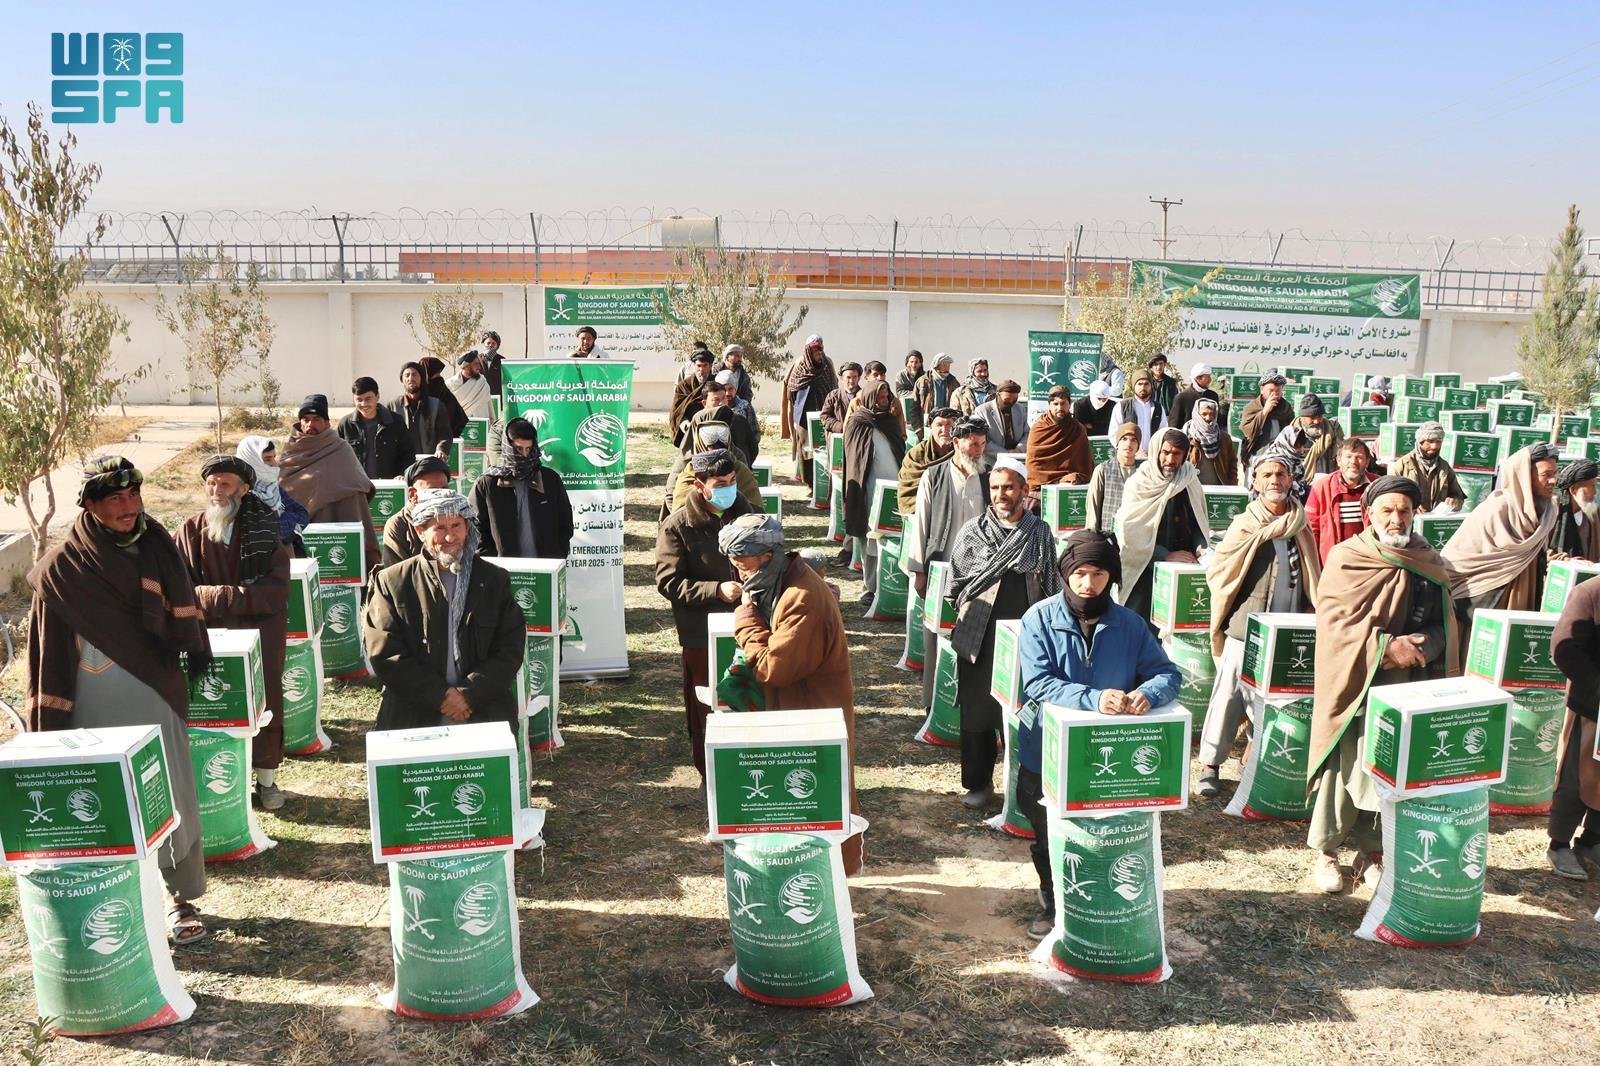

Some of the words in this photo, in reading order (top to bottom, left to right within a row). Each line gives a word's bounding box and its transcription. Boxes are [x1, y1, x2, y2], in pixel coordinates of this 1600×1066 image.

[1262, 272, 1301, 284] العربية
[1303, 274, 1348, 285] المملكة
[1207, 282, 1257, 293] KINGDOM
[1259, 286, 1274, 295] OF
[1275, 287, 1308, 296] SAUDI
[1310, 288, 1349, 297] ARABIA
[507, 381, 554, 392] السعودية
[556, 379, 590, 392] العربية
[591, 380, 628, 390] المملكة
[507, 394, 552, 403] KINGDOM
[553, 394, 565, 402] OF
[567, 393, 595, 402] SAUDI
[596, 393, 628, 401] ARABIA
[572, 545, 618, 555] EMERGENCIES
[570, 559, 587, 568] YEAR
[588, 559, 605, 567] 2025
[738, 752, 769, 760] السعودية
[402, 768, 434, 776] السعودية
[435, 766, 458, 774] العربية
[458, 763, 485, 771] المملكة
[16, 780, 46, 788] KINGDOM
[74, 777, 97, 785] ARABIA
[1402, 809, 1441, 822] KINGDOM
[1442, 816, 1454, 824] OF
[1455, 817, 1474, 826] SAUDI
[1099, 838, 1123, 847] SAUDI
[1124, 832, 1149, 844] ARABIA
[766, 856, 793, 866] SAUDI
[794, 847, 823, 863] ARABIA
[440, 869, 469, 880] SAUDI
[52, 890, 65, 898] OF
[67, 885, 97, 897] SAUDI
[98, 869, 133, 890] ARABIA
